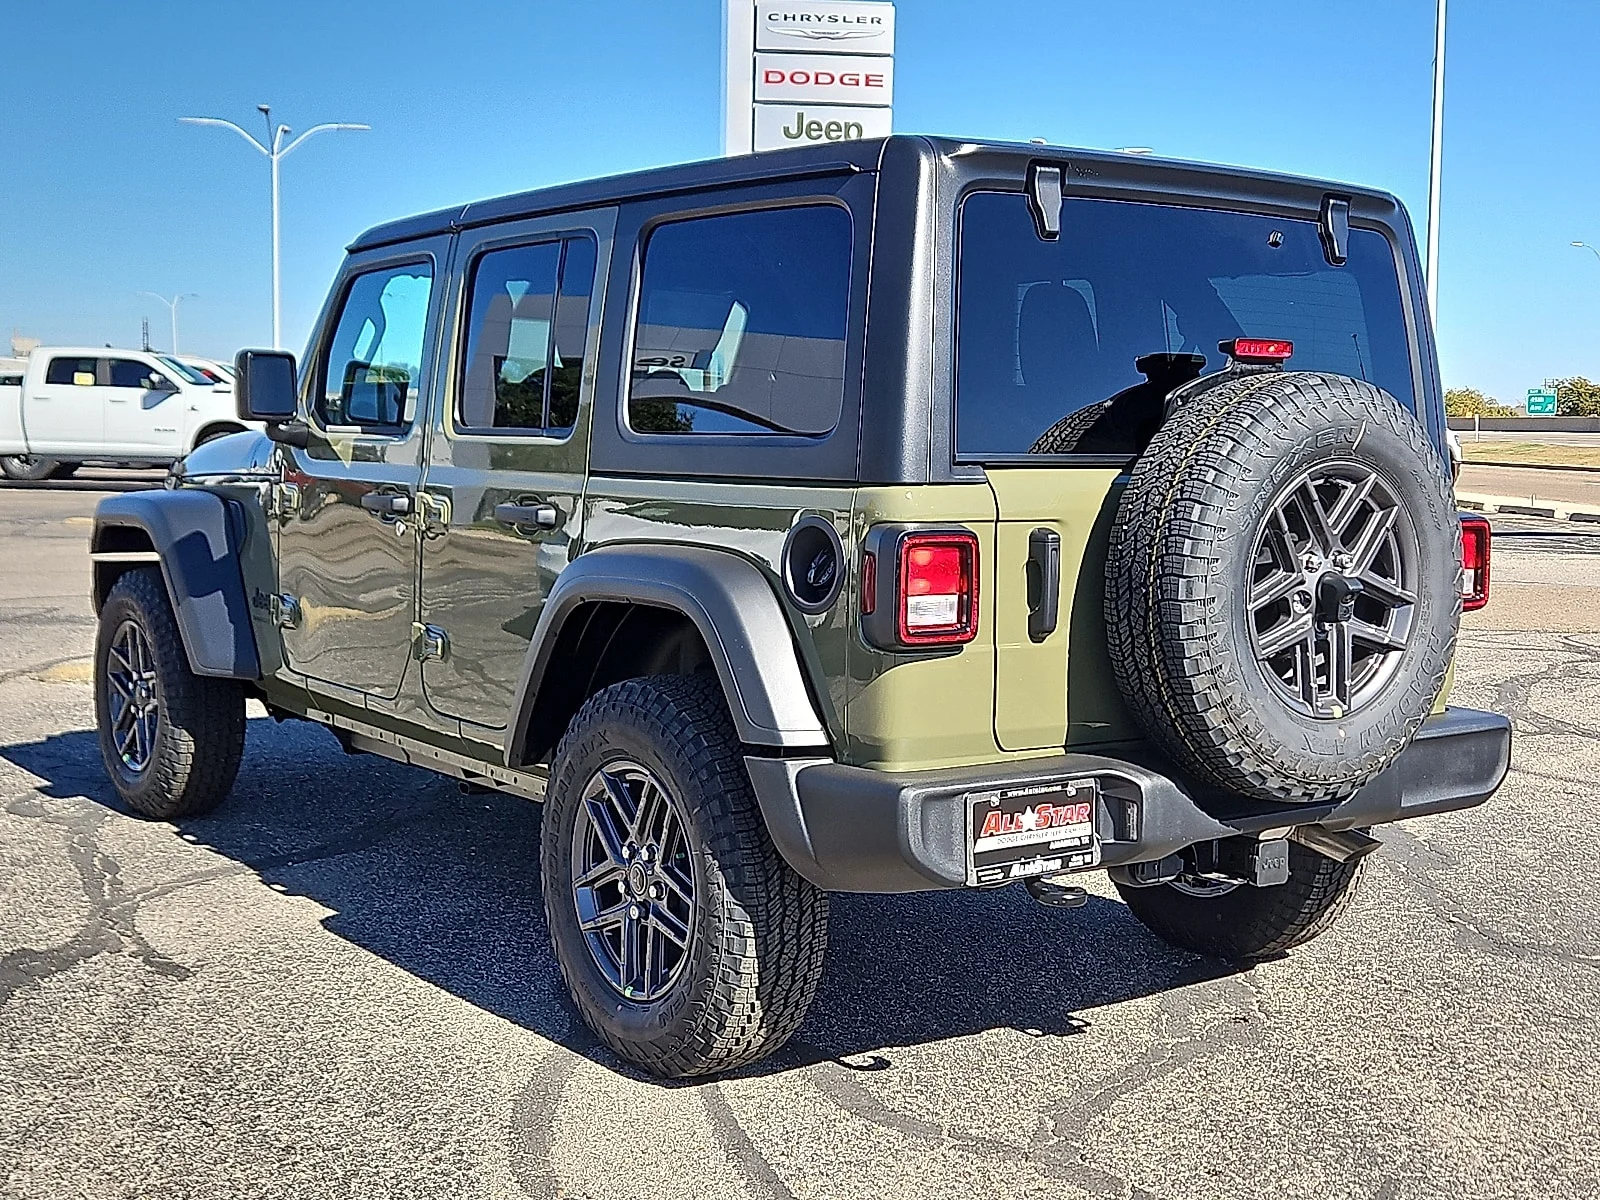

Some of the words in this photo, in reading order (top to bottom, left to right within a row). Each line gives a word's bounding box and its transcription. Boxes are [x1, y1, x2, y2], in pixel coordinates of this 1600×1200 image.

[767, 13, 882, 25] CHRYSLER
[763, 70, 884, 88] DODGE
[980, 810, 1023, 838] ALL
[1034, 803, 1091, 830] STAR
